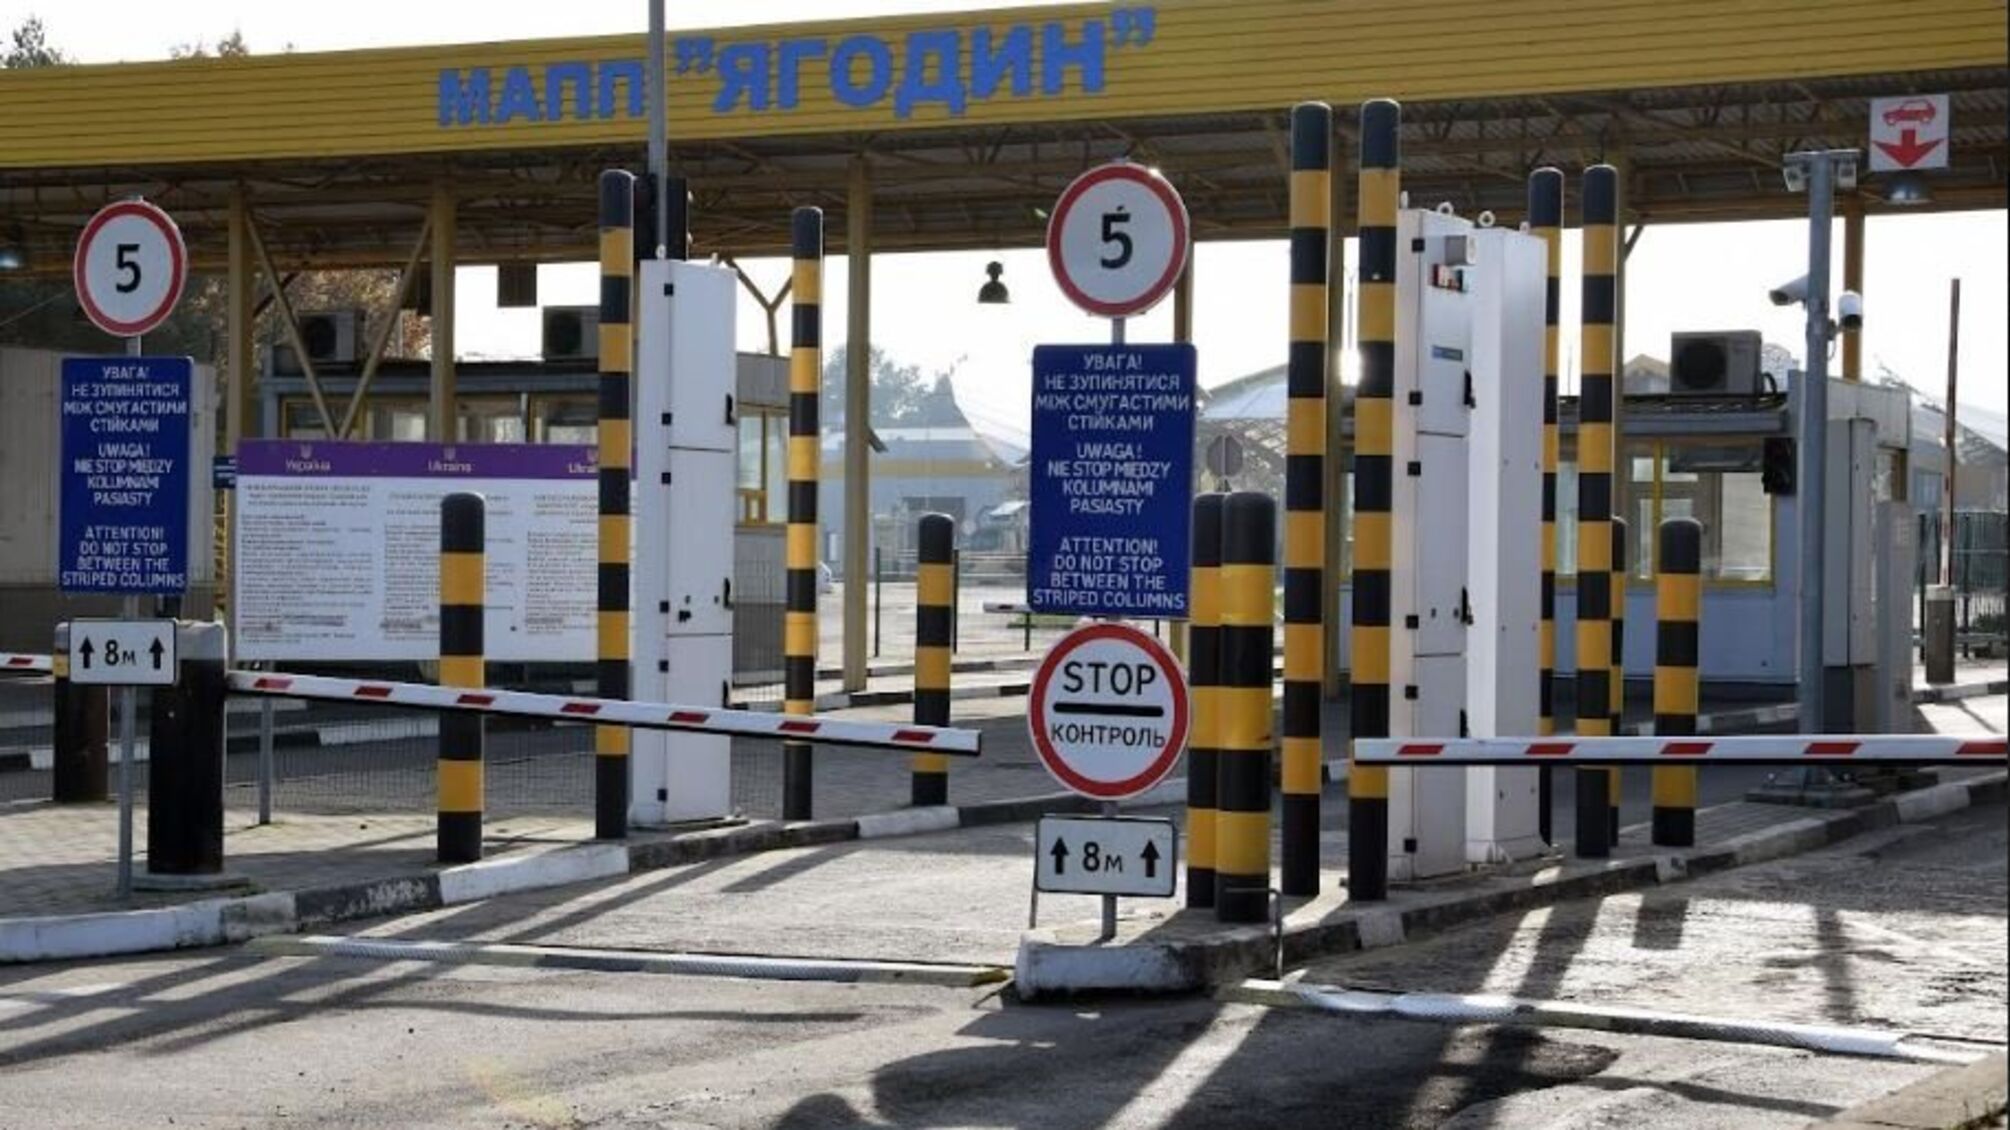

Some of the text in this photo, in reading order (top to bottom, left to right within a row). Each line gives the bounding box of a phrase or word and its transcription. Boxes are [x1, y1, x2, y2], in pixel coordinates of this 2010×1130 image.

[439, 59, 645, 127] МАПП
[1100, 213, 1133, 270] 5
[116, 244, 141, 293] 5
[1083, 354, 1142, 370] УВАГА!
[72, 384, 179, 397] НЕ ЗУПИНЯТИСЯ
[1045, 375, 1180, 390] НЕ ЗУПИНЯТИСЯ
[95, 401, 187, 415] СМУГАСТИМИ
[1036, 395, 1189, 411] МІЖ СМУГАСТИМИ
[1068, 411, 1153, 430] СТІЙКАМИ
[95, 459, 126, 473] STOP
[1048, 461, 1070, 477] NIE
[1073, 461, 1111, 477] STOP
[1063, 480, 1153, 496] KOLUMNAMI
[1070, 499, 1144, 515] PASIASTY
[85, 526, 164, 540] ATTENTION!
[79, 541, 168, 556] DO NOT STOP
[1060, 538, 1158, 554] ATTENTION!
[77, 556, 169, 572] BETWEEN THE
[1054, 555, 1163, 572] DO NOT STOP
[62, 571, 185, 587] STRIPED COLUMNS
[1051, 572, 1166, 590] BETWEEN THE
[1033, 589, 1184, 609] STRIPED COLUMNS
[1062, 661, 1156, 696] STOP
[1051, 723, 1166, 748] КОНТРОЛЬ
